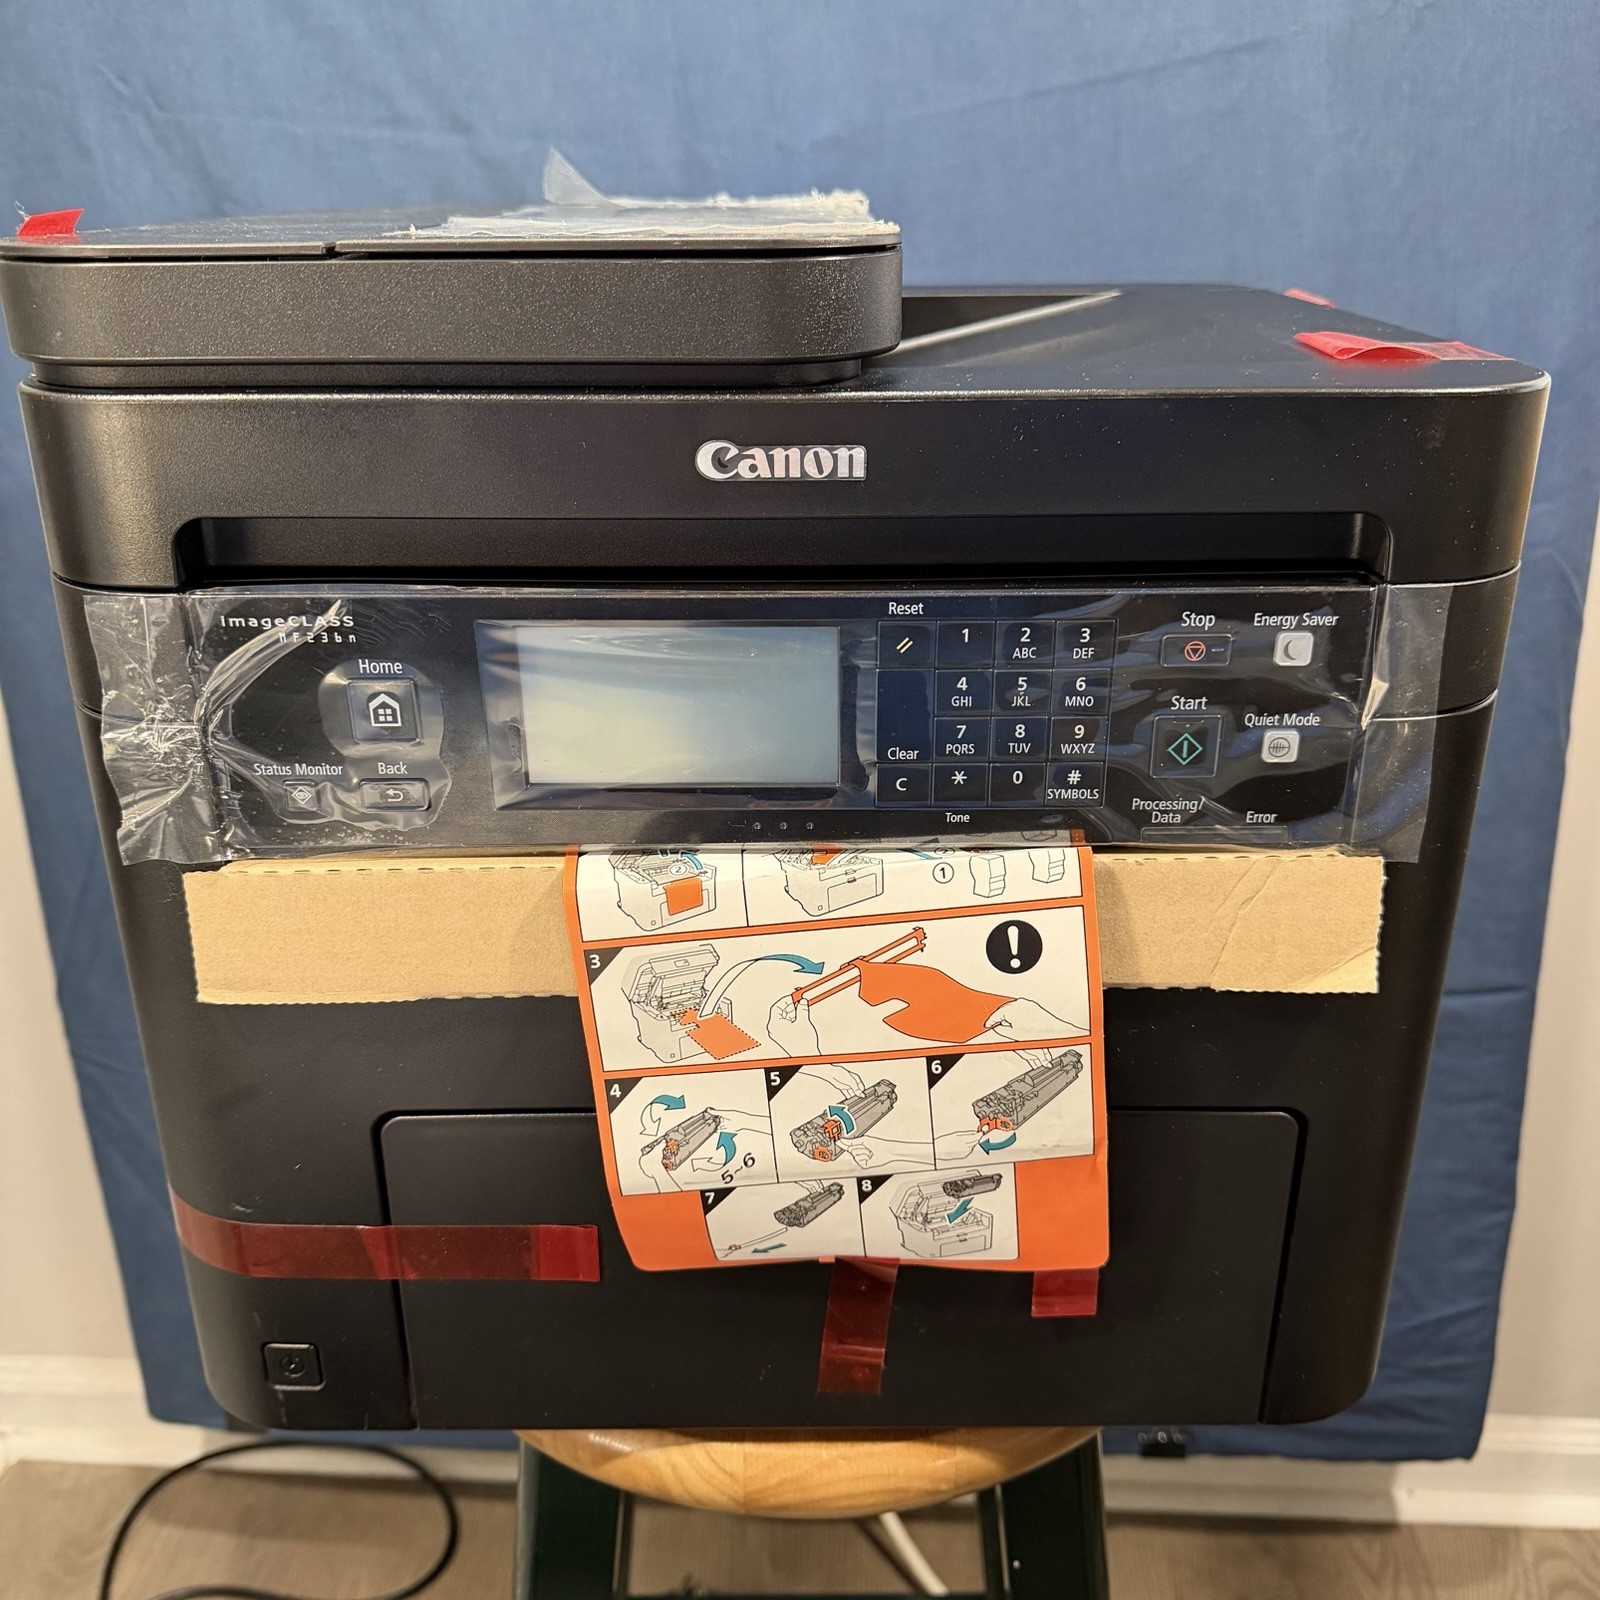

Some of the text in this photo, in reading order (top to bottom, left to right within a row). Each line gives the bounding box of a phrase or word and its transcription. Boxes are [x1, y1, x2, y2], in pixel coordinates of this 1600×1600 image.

[697, 441, 865, 479] Canon
[888, 602, 924, 615] Reset
[220, 615, 355, 630] imageCLASS
[1181, 611, 1215, 630] Stop
[1253, 613, 1340, 629] Energy Saver
[961, 628, 969, 643] 1
[1020, 628, 1031, 642] 2
[1080, 628, 1090, 642] 3
[1012, 648, 1037, 659] ABC
[1073, 648, 1095, 659] DEF
[359, 659, 403, 674] Home
[956, 677, 968, 691] 4
[1017, 677, 1028, 691] 5
[1075, 677, 1086, 691] 6
[951, 696, 972, 707] GHI
[1012, 696, 1031, 707] JKL
[1065, 696, 1094, 707] MNO
[1171, 696, 1208, 710] Start
[1244, 713, 1320, 727] Quiet Mode
[956, 725, 967, 739] 7
[1015, 724, 1026, 738] 8
[1074, 725, 1085, 739] 9
[887, 747, 919, 760] Clear
[945, 744, 975, 756] PQRS
[1008, 743, 1031, 754] TUV
[1060, 744, 1095, 754] WXYZ
[254, 763, 343, 775] Status Monitor
[378, 762, 408, 775] Back
[895, 777, 907, 791] C
[1012, 771, 1023, 785] 0
[1047, 788, 1099, 800] SYMBOLS
[1132, 797, 1204, 813] Processing/
[945, 813, 970, 823] Tone
[1151, 812, 1181, 823] Data
[1246, 811, 1277, 823] Error
[590, 954, 601, 969] 3
[931, 1060, 942, 1074] 6
[770, 1072, 781, 1086] 5
[610, 1084, 622, 1098] 4
[861, 1180, 872, 1192] 8
[705, 1192, 715, 1205] 7
